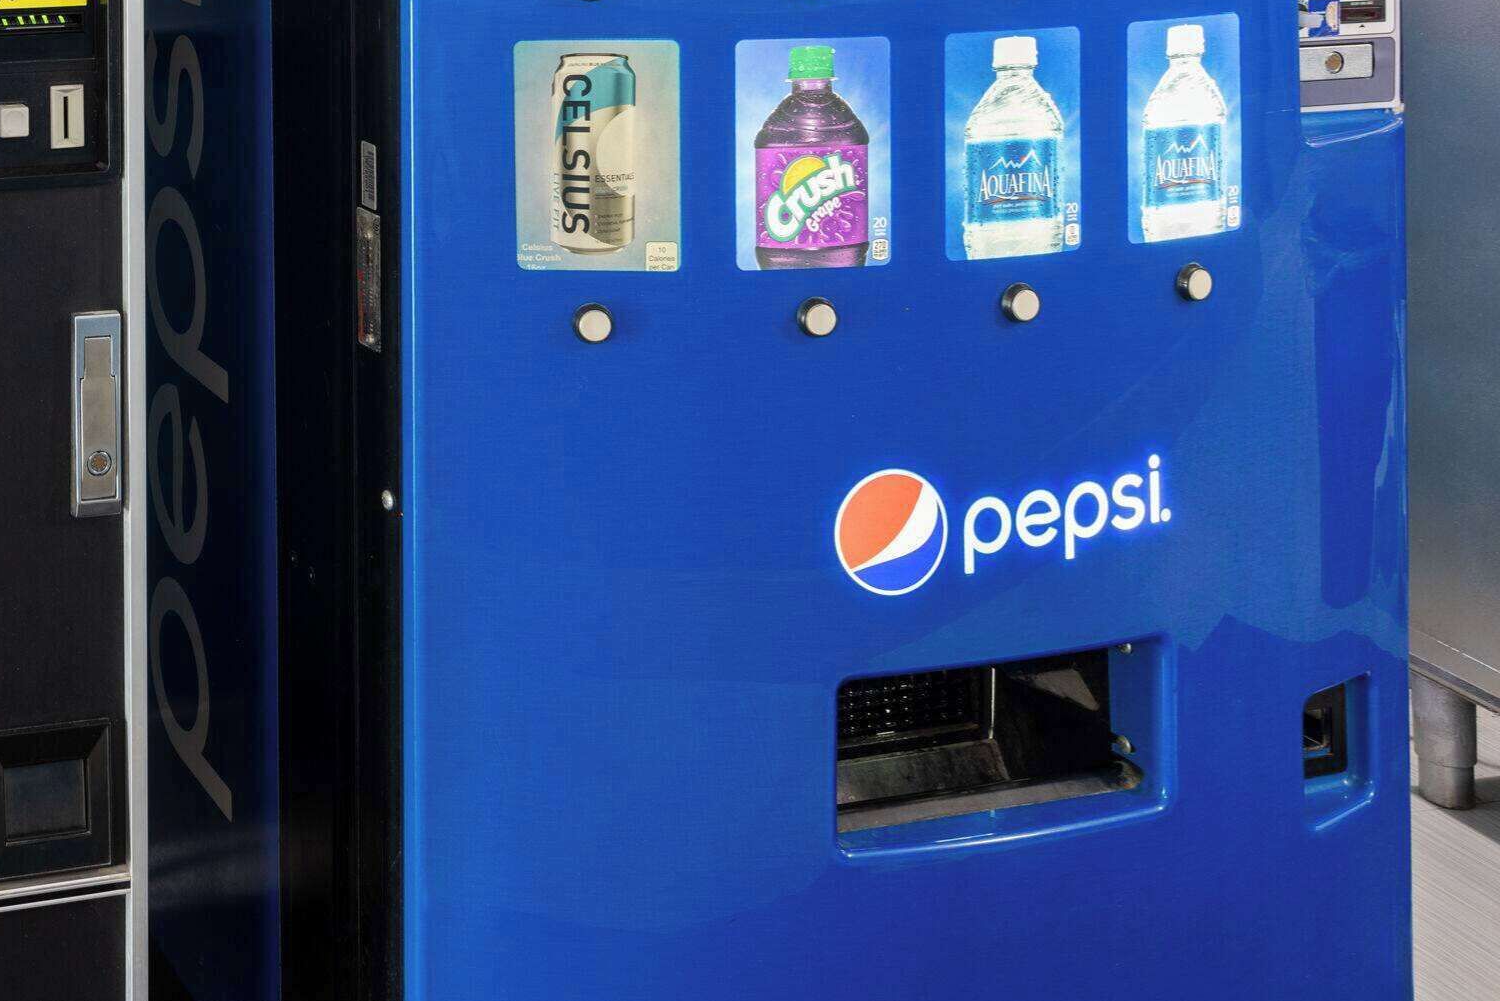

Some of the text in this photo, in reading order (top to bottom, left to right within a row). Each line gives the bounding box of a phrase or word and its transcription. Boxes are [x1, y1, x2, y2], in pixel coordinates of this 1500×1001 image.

[561, 73, 592, 236] CELSIUS
[1153, 152, 1218, 187] AQUAFINA
[766, 154, 857, 241] Crush
[979, 166, 1054, 204] AQUAFINA
[805, 196, 843, 233] Grape
[872, 216, 887, 228] 20
[521, 243, 554, 251] Celsius
[649, 254, 675, 263] Calories
